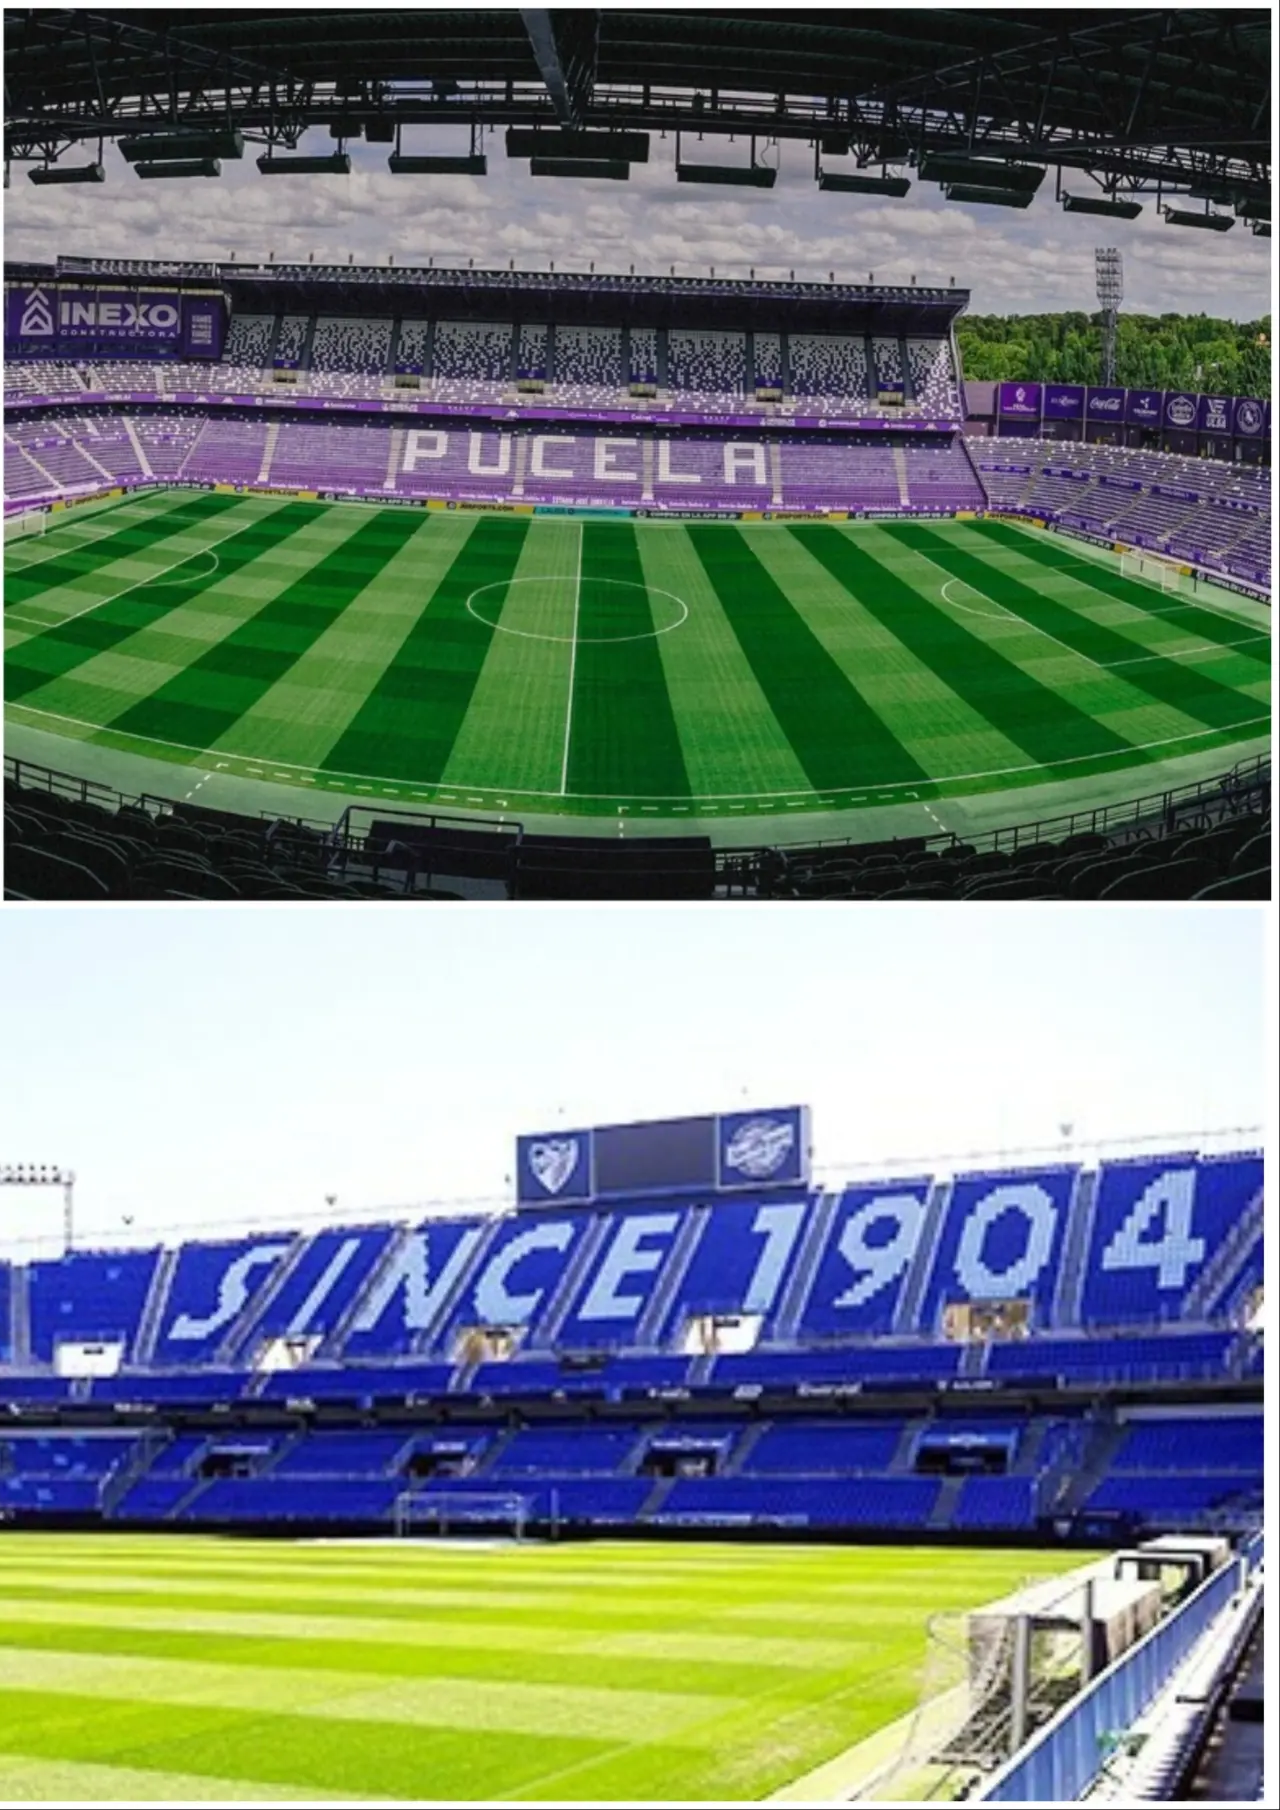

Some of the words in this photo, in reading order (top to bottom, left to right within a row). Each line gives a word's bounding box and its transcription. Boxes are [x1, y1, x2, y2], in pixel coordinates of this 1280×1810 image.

[60, 328, 176, 338] CONSTRUCTORA
[61, 302, 178, 327] INEXO
[402, 429, 767, 484] PUCELA
[169, 1213, 680, 1340] SINCE
[742, 1169, 1204, 1313] 1904
